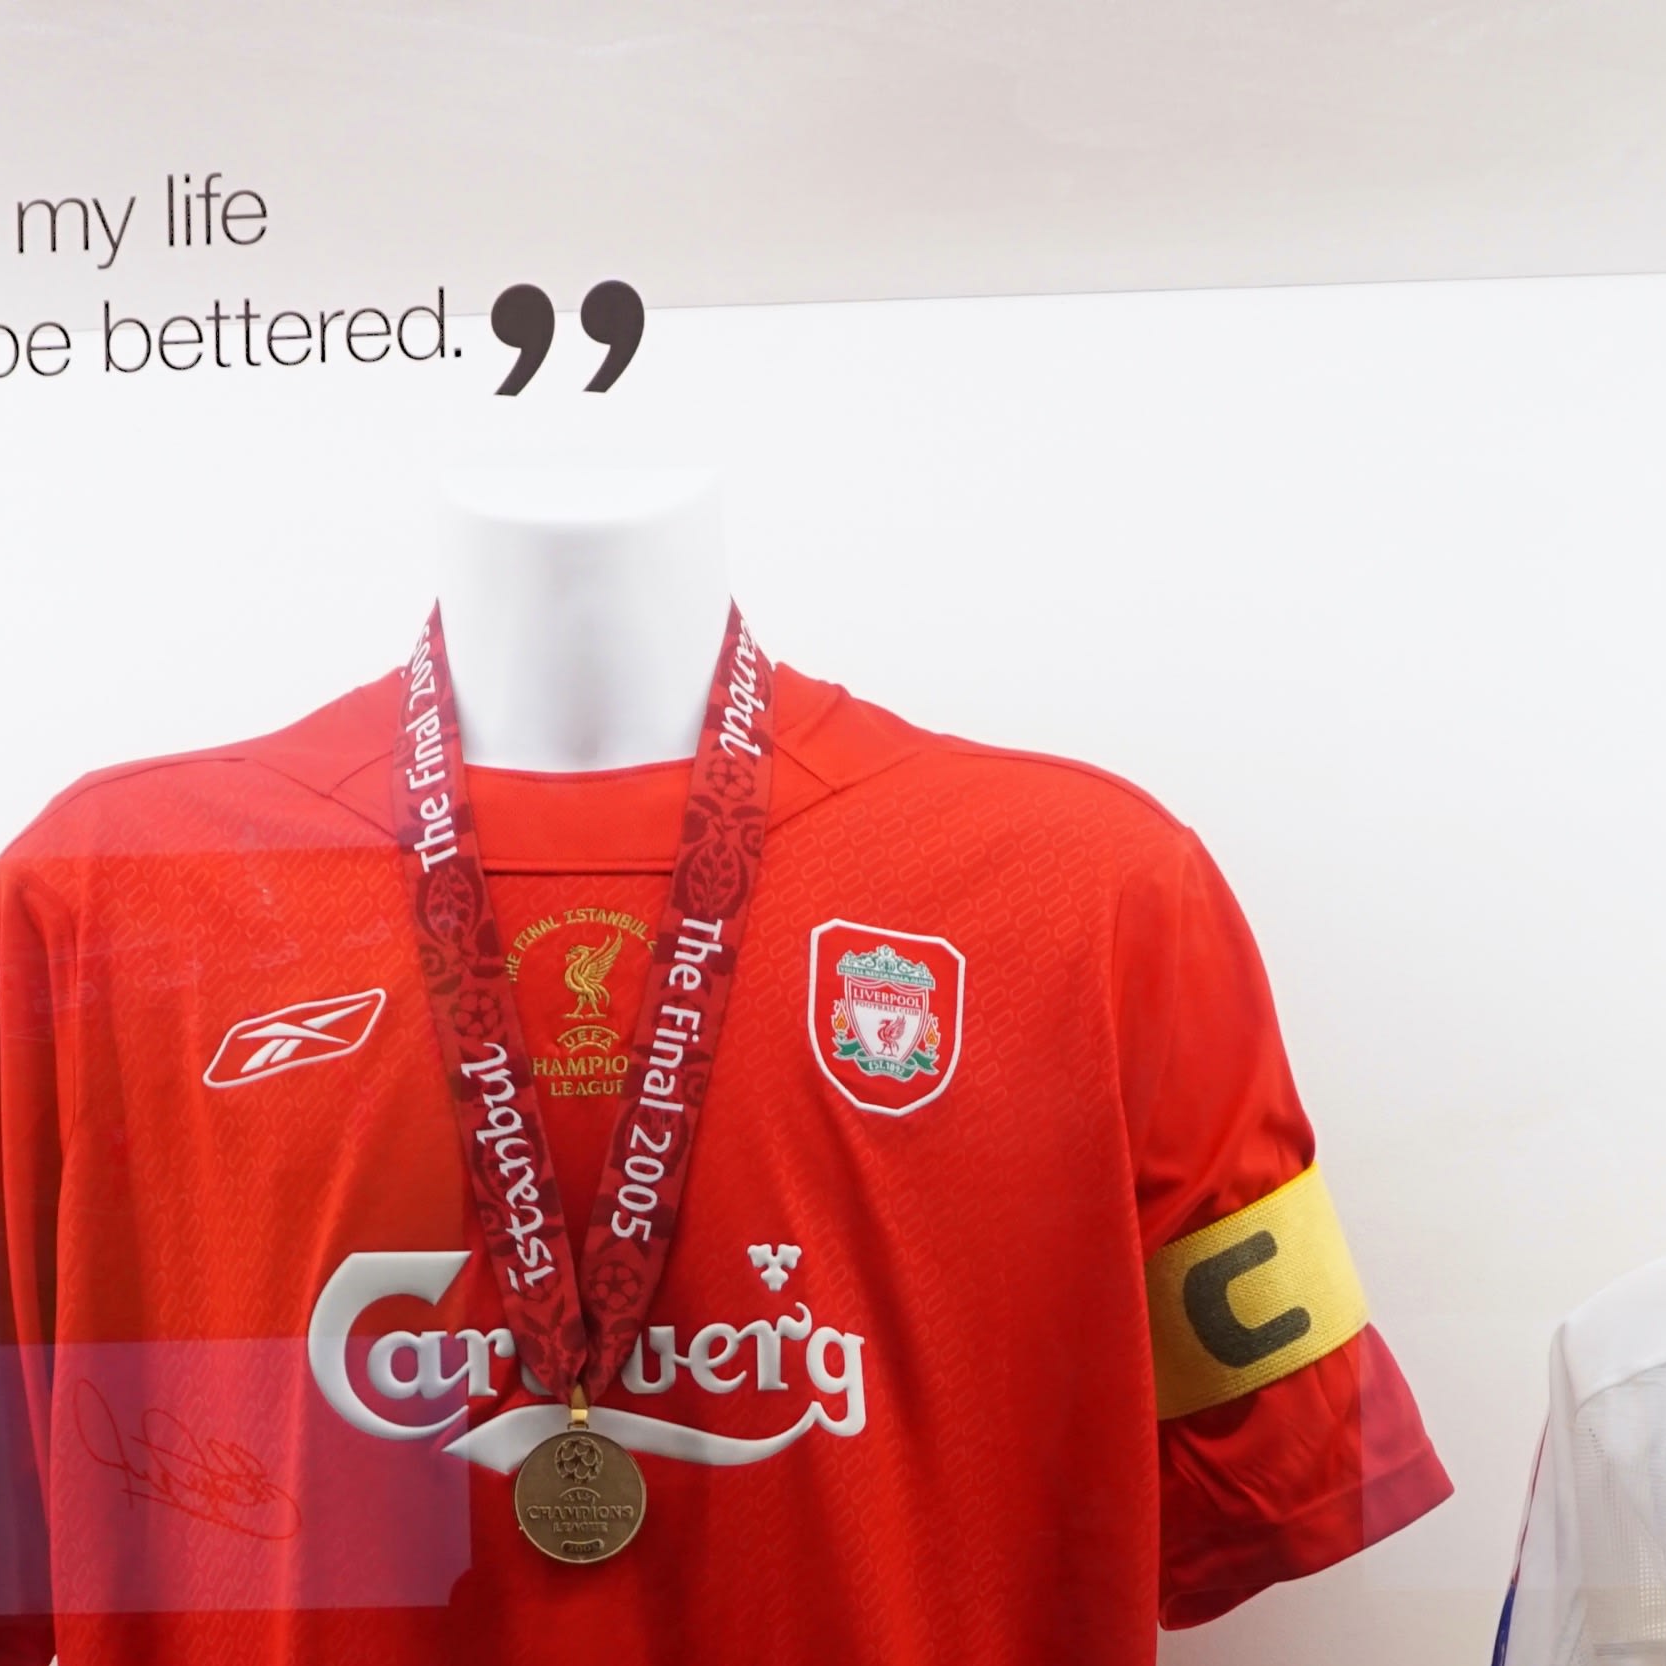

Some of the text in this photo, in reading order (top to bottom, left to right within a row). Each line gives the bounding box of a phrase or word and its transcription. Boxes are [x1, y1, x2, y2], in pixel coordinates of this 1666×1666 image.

[16, 195, 137, 271] my
[166, 171, 269, 249] life
[103, 285, 463, 375] bettered.
[406, 704, 445, 790] Final
[414, 793, 457, 873] The
[561, 1029, 614, 1050] UEFA
[853, 988, 921, 1008] LIVERPOOL
[532, 1055, 631, 1077] HAMPIO
[611, 917, 724, 1243] The Final 2005
[1182, 1229, 1312, 1369] C
